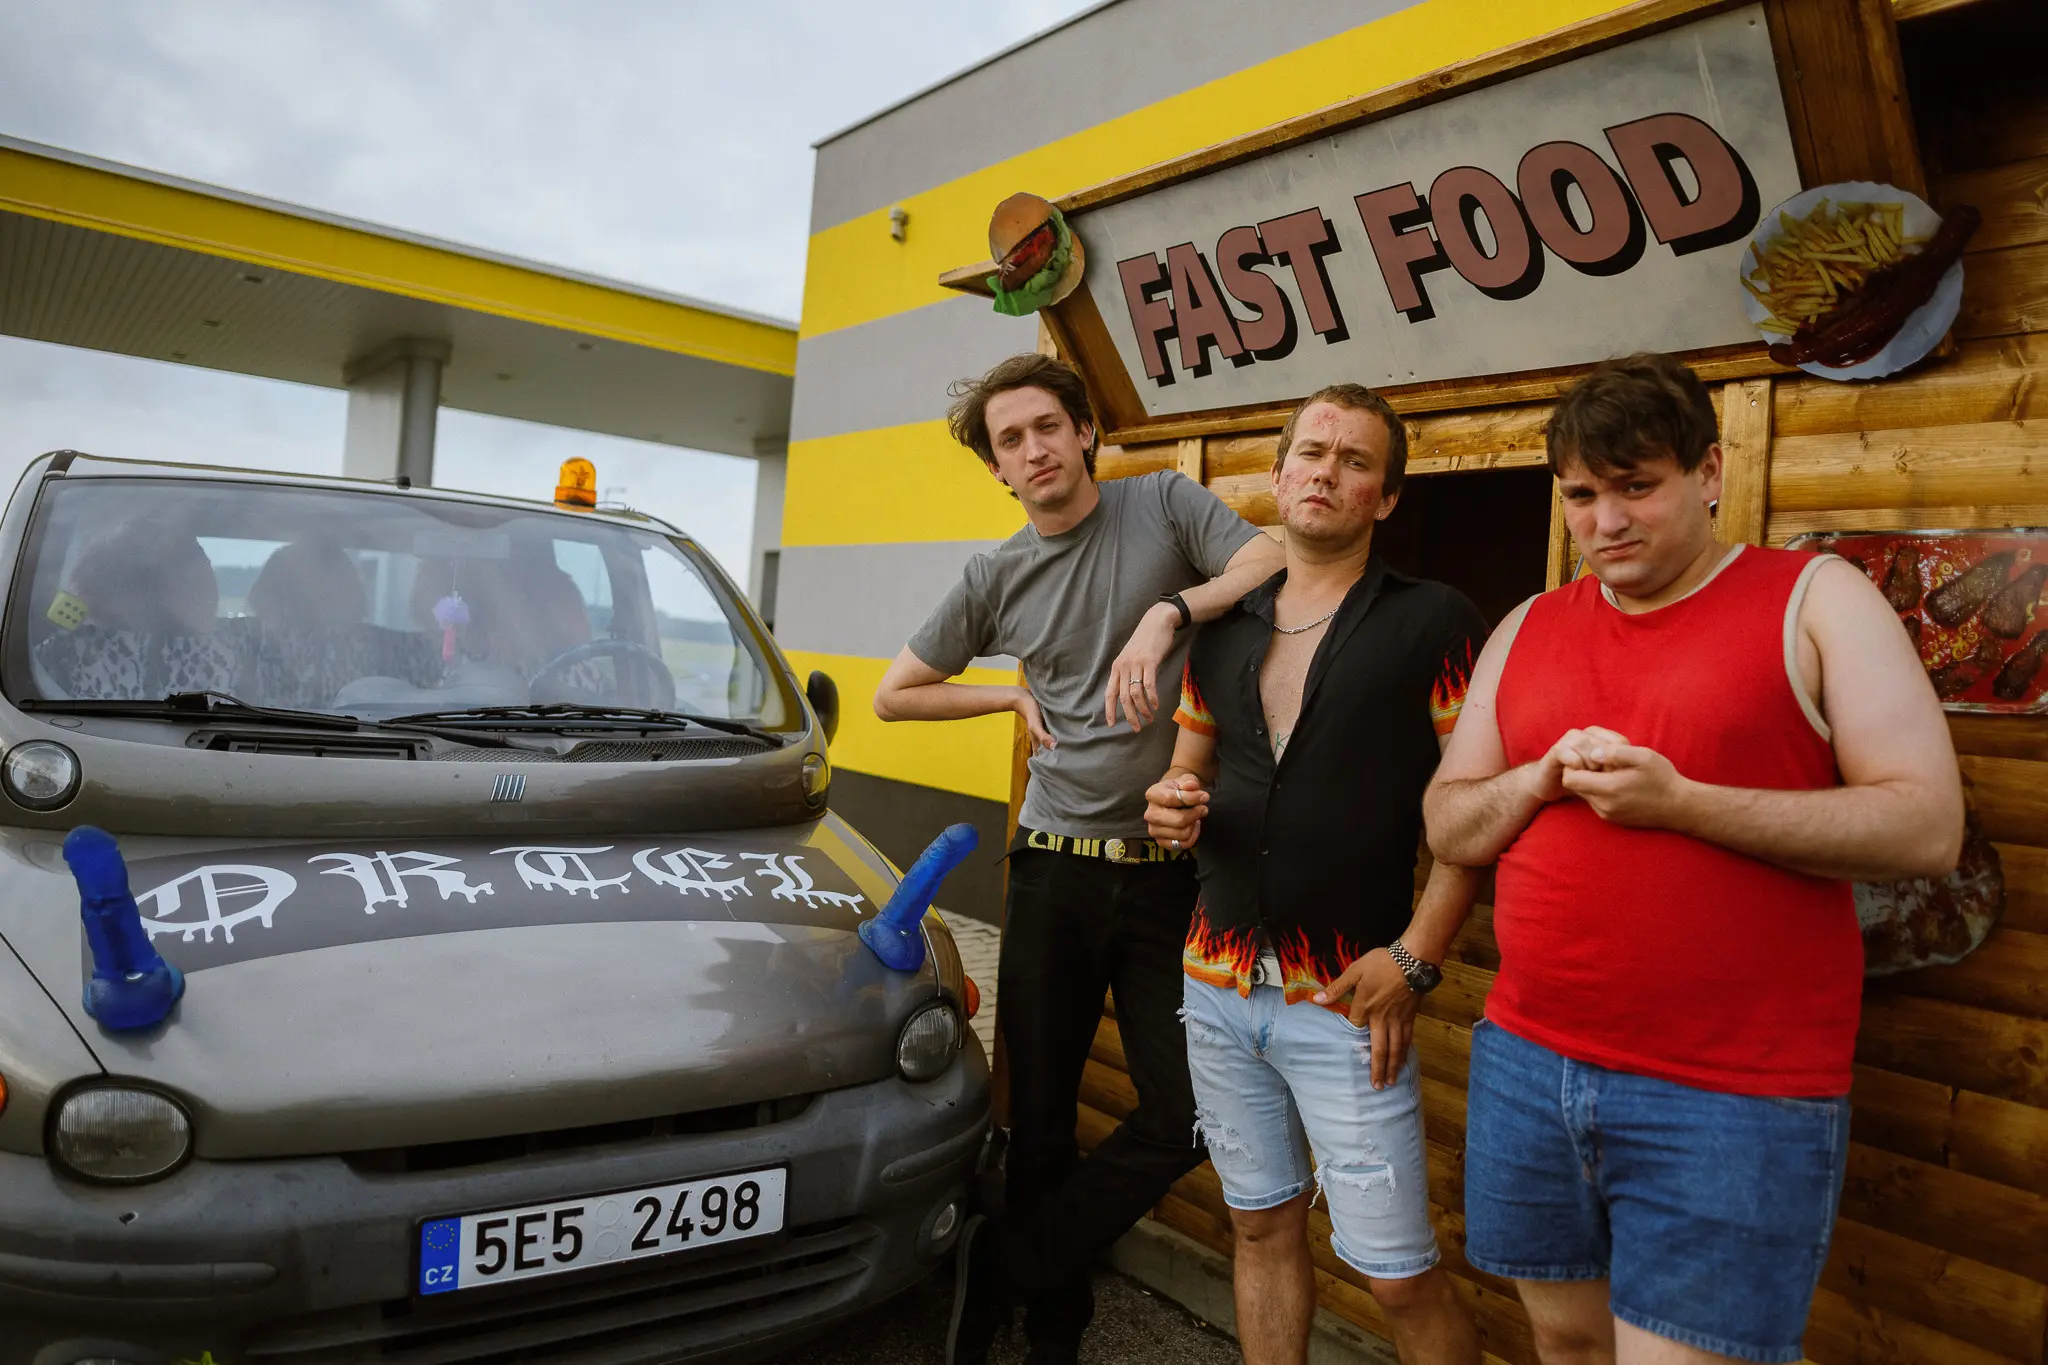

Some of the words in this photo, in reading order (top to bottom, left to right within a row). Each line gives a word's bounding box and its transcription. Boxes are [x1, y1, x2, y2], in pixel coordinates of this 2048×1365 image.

[1117, 206, 1350, 387] FAST
[1353, 112, 1761, 324] FOOD
[136, 845, 865, 944] ORTEL
[424, 1264, 454, 1286] CZ
[474, 1205, 585, 1276] 5E5
[630, 1180, 761, 1251] 2498
